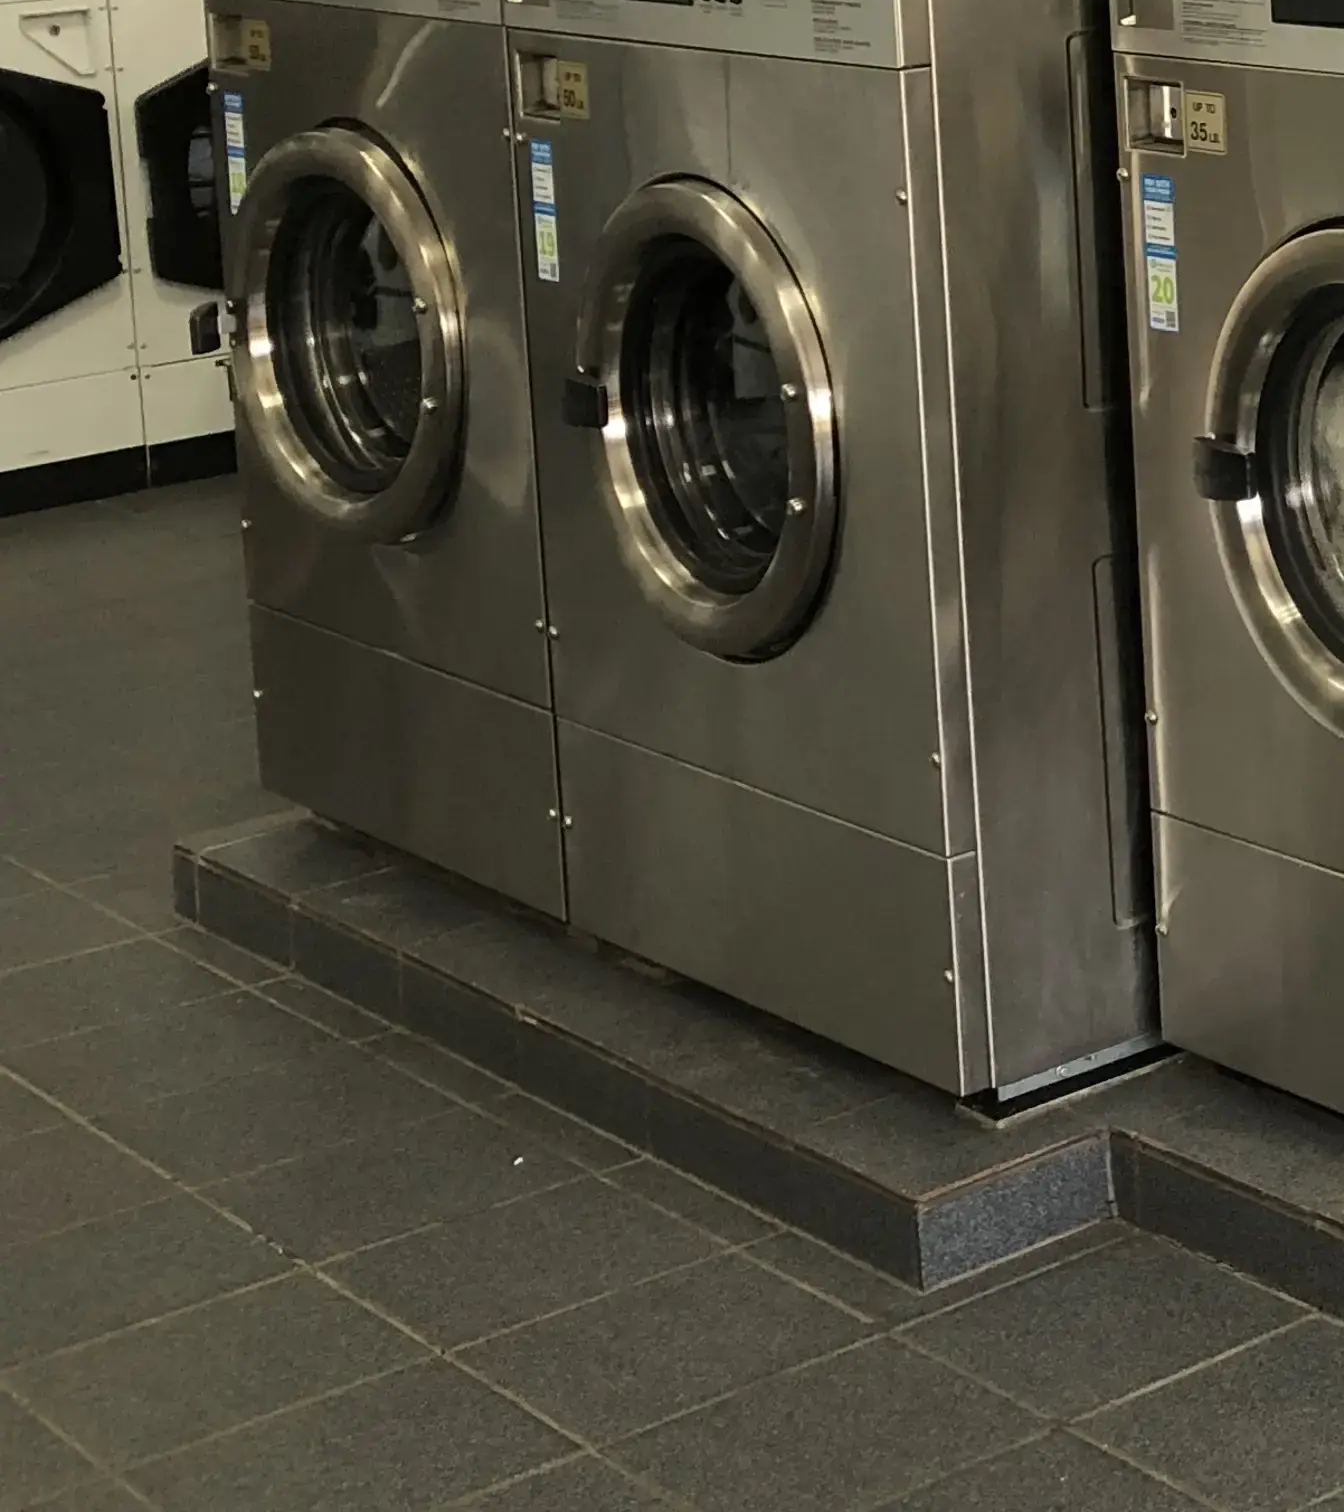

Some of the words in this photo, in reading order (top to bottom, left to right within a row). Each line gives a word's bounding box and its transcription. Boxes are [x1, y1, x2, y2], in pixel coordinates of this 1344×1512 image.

[563, 89, 575, 107] 50
[1193, 102, 1202, 111] UP
[1204, 103, 1215, 114] TO
[1191, 121, 1207, 141] 35
[1151, 275, 1174, 304] 20
